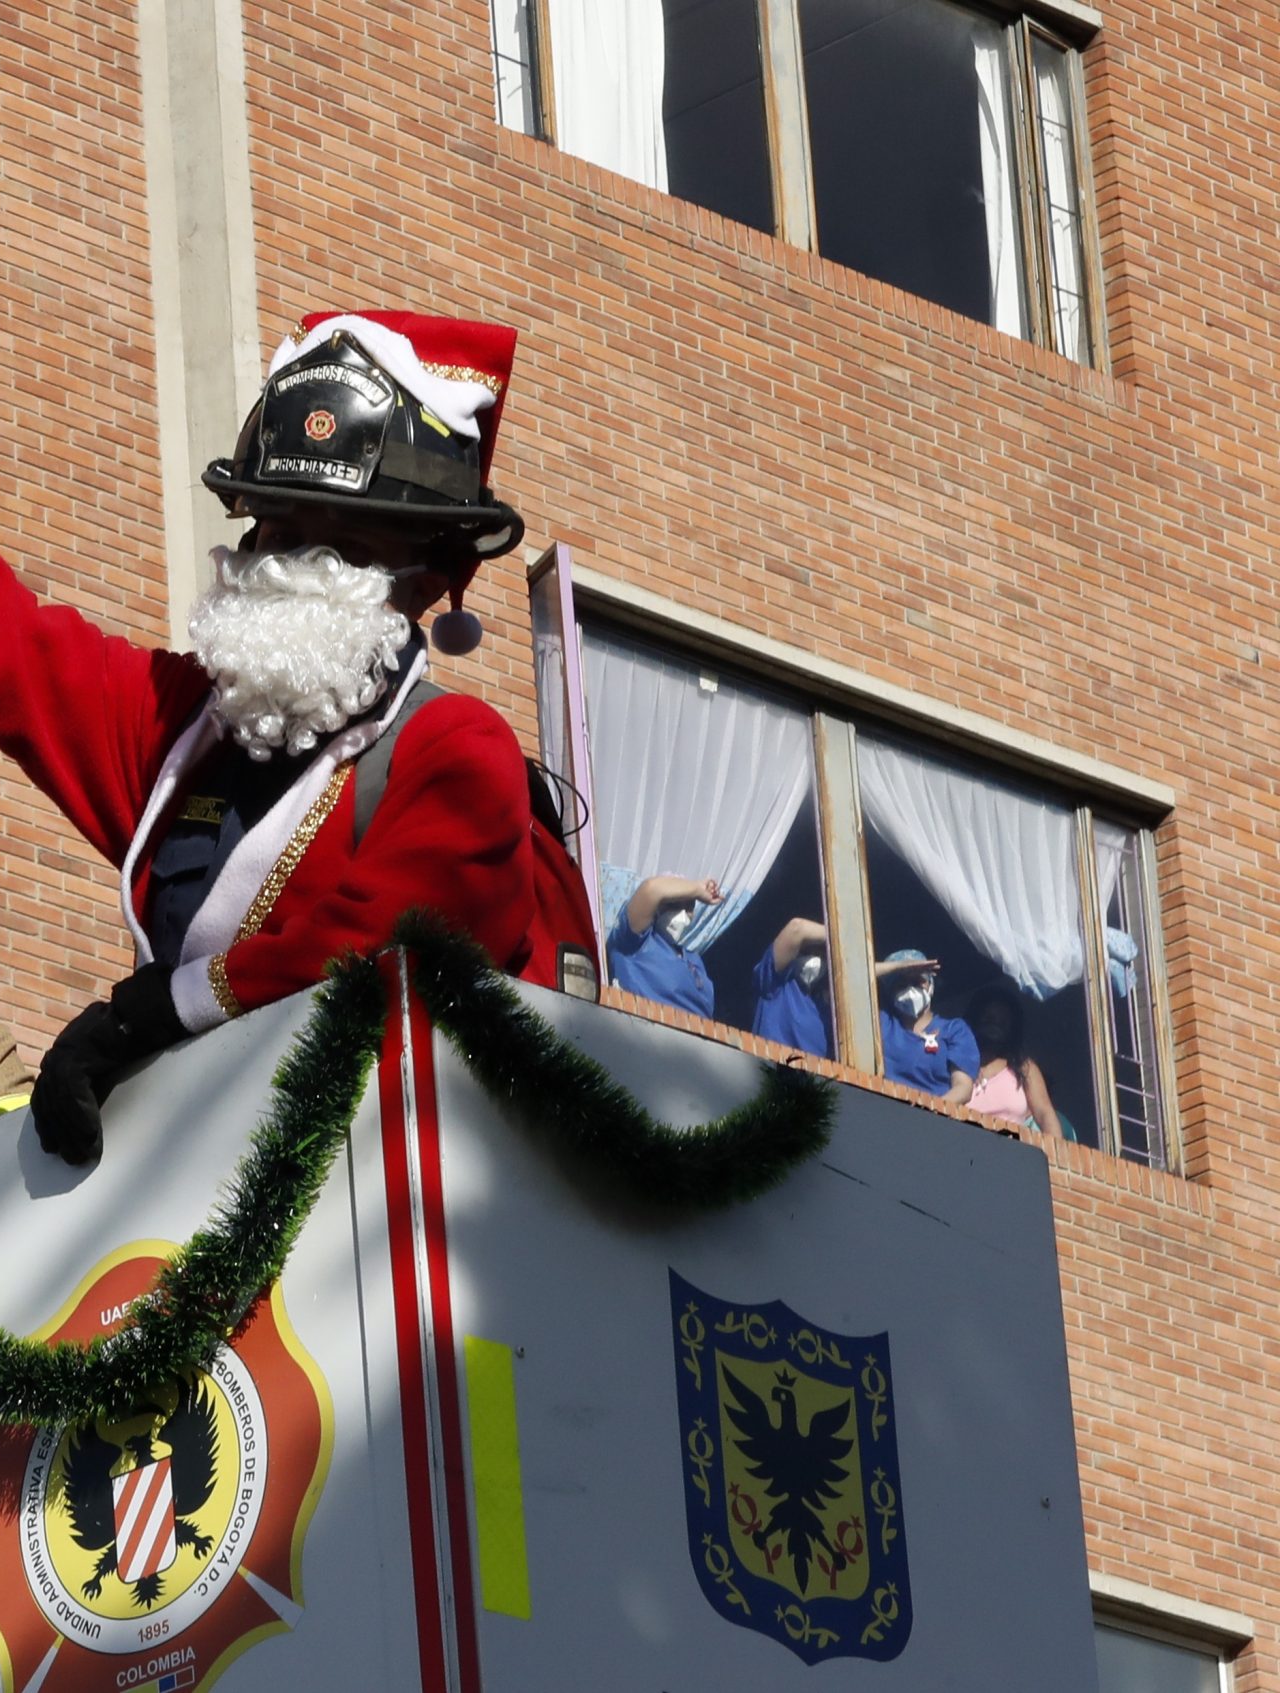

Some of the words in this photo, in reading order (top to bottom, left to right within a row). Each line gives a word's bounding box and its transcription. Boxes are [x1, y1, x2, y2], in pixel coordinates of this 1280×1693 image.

[216, 1361, 256, 1453] BOMBEROS
[244, 1457, 256, 1482] DE
[27, 1464, 59, 1602] ADMINISTRATIVA
[219, 1488, 253, 1567] BOGOTÁ
[194, 1567, 220, 1597] D.C.
[56, 1600, 101, 1640] UNIDAD
[138, 1619, 170, 1643] 1895
[116, 1646, 196, 1687] COLOMBIA
